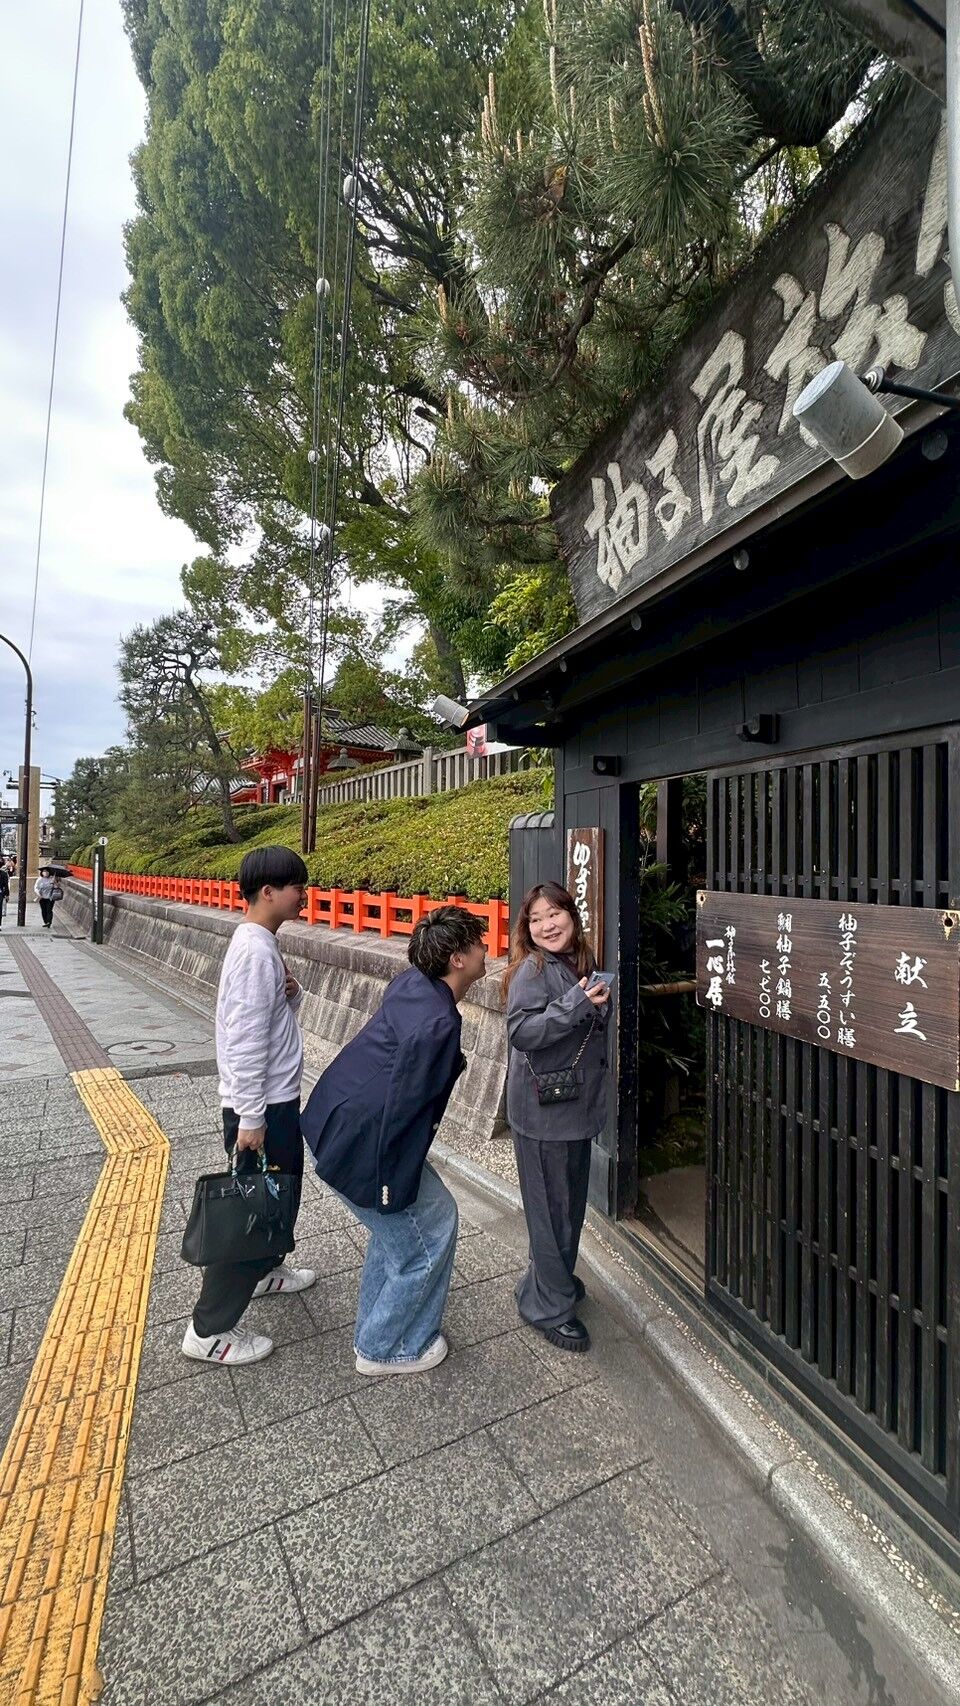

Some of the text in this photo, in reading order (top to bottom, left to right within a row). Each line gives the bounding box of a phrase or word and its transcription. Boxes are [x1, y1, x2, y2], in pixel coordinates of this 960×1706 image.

[705, 938, 726, 1007] 一心居
[837, 912, 858, 1049] 柚子ぞうすい膳
[893, 951, 929, 1042] 献立
